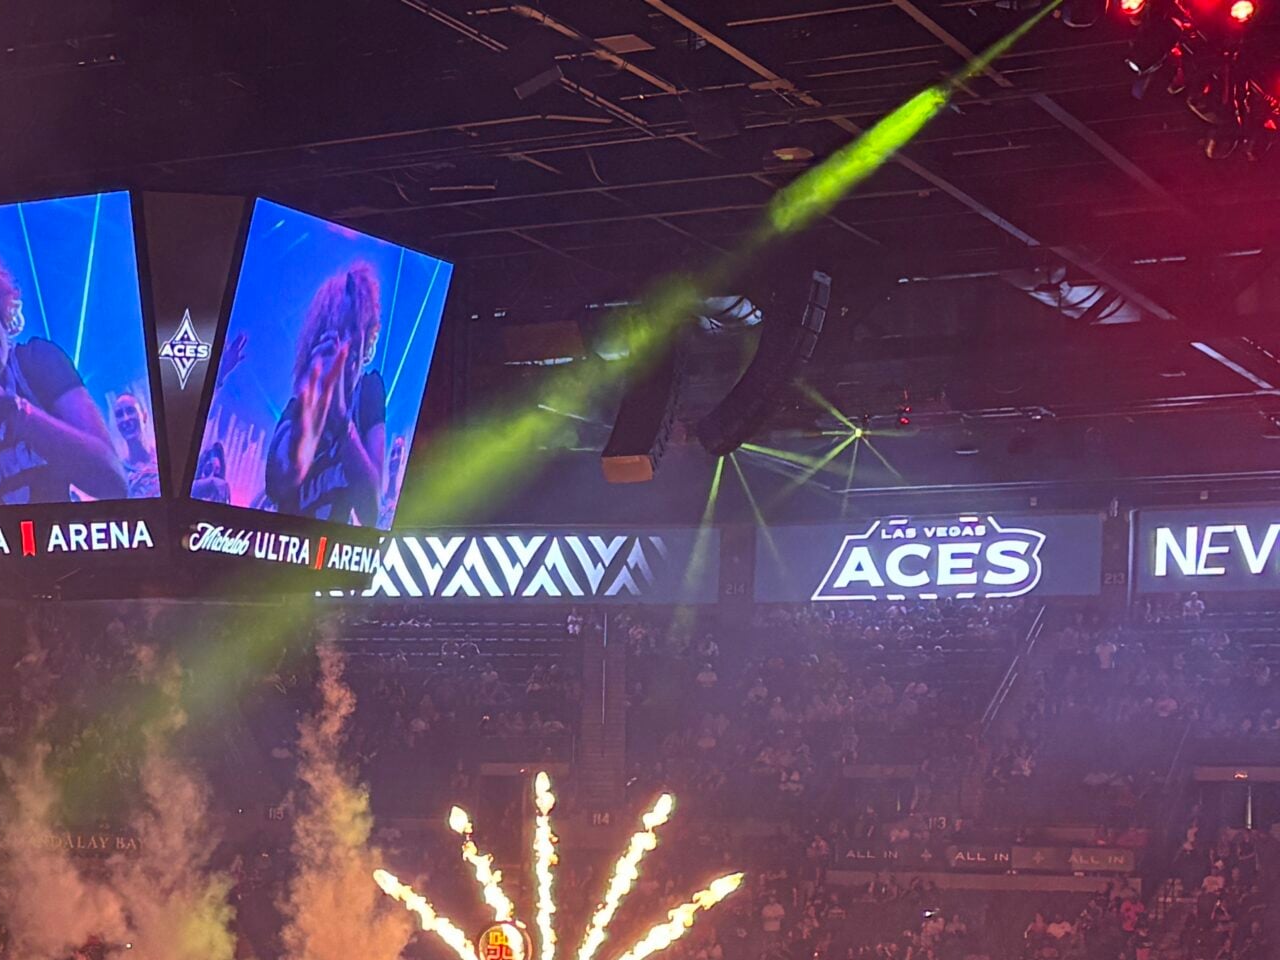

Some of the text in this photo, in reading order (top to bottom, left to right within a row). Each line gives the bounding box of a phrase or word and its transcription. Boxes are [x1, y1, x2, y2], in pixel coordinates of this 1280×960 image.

[161, 344, 208, 358] ACES
[47, 520, 153, 553] ARENA
[881, 525, 986, 539] LAS VEGAS
[189, 522, 382, 575] Michelob ULTRA ARENA
[832, 540, 1031, 588] ACES
[1103, 572, 1126, 585] 213
[845, 849, 899, 860] ALL IN
[954, 851, 1010, 862] ALL IN
[1068, 854, 1125, 865] ALL IN
